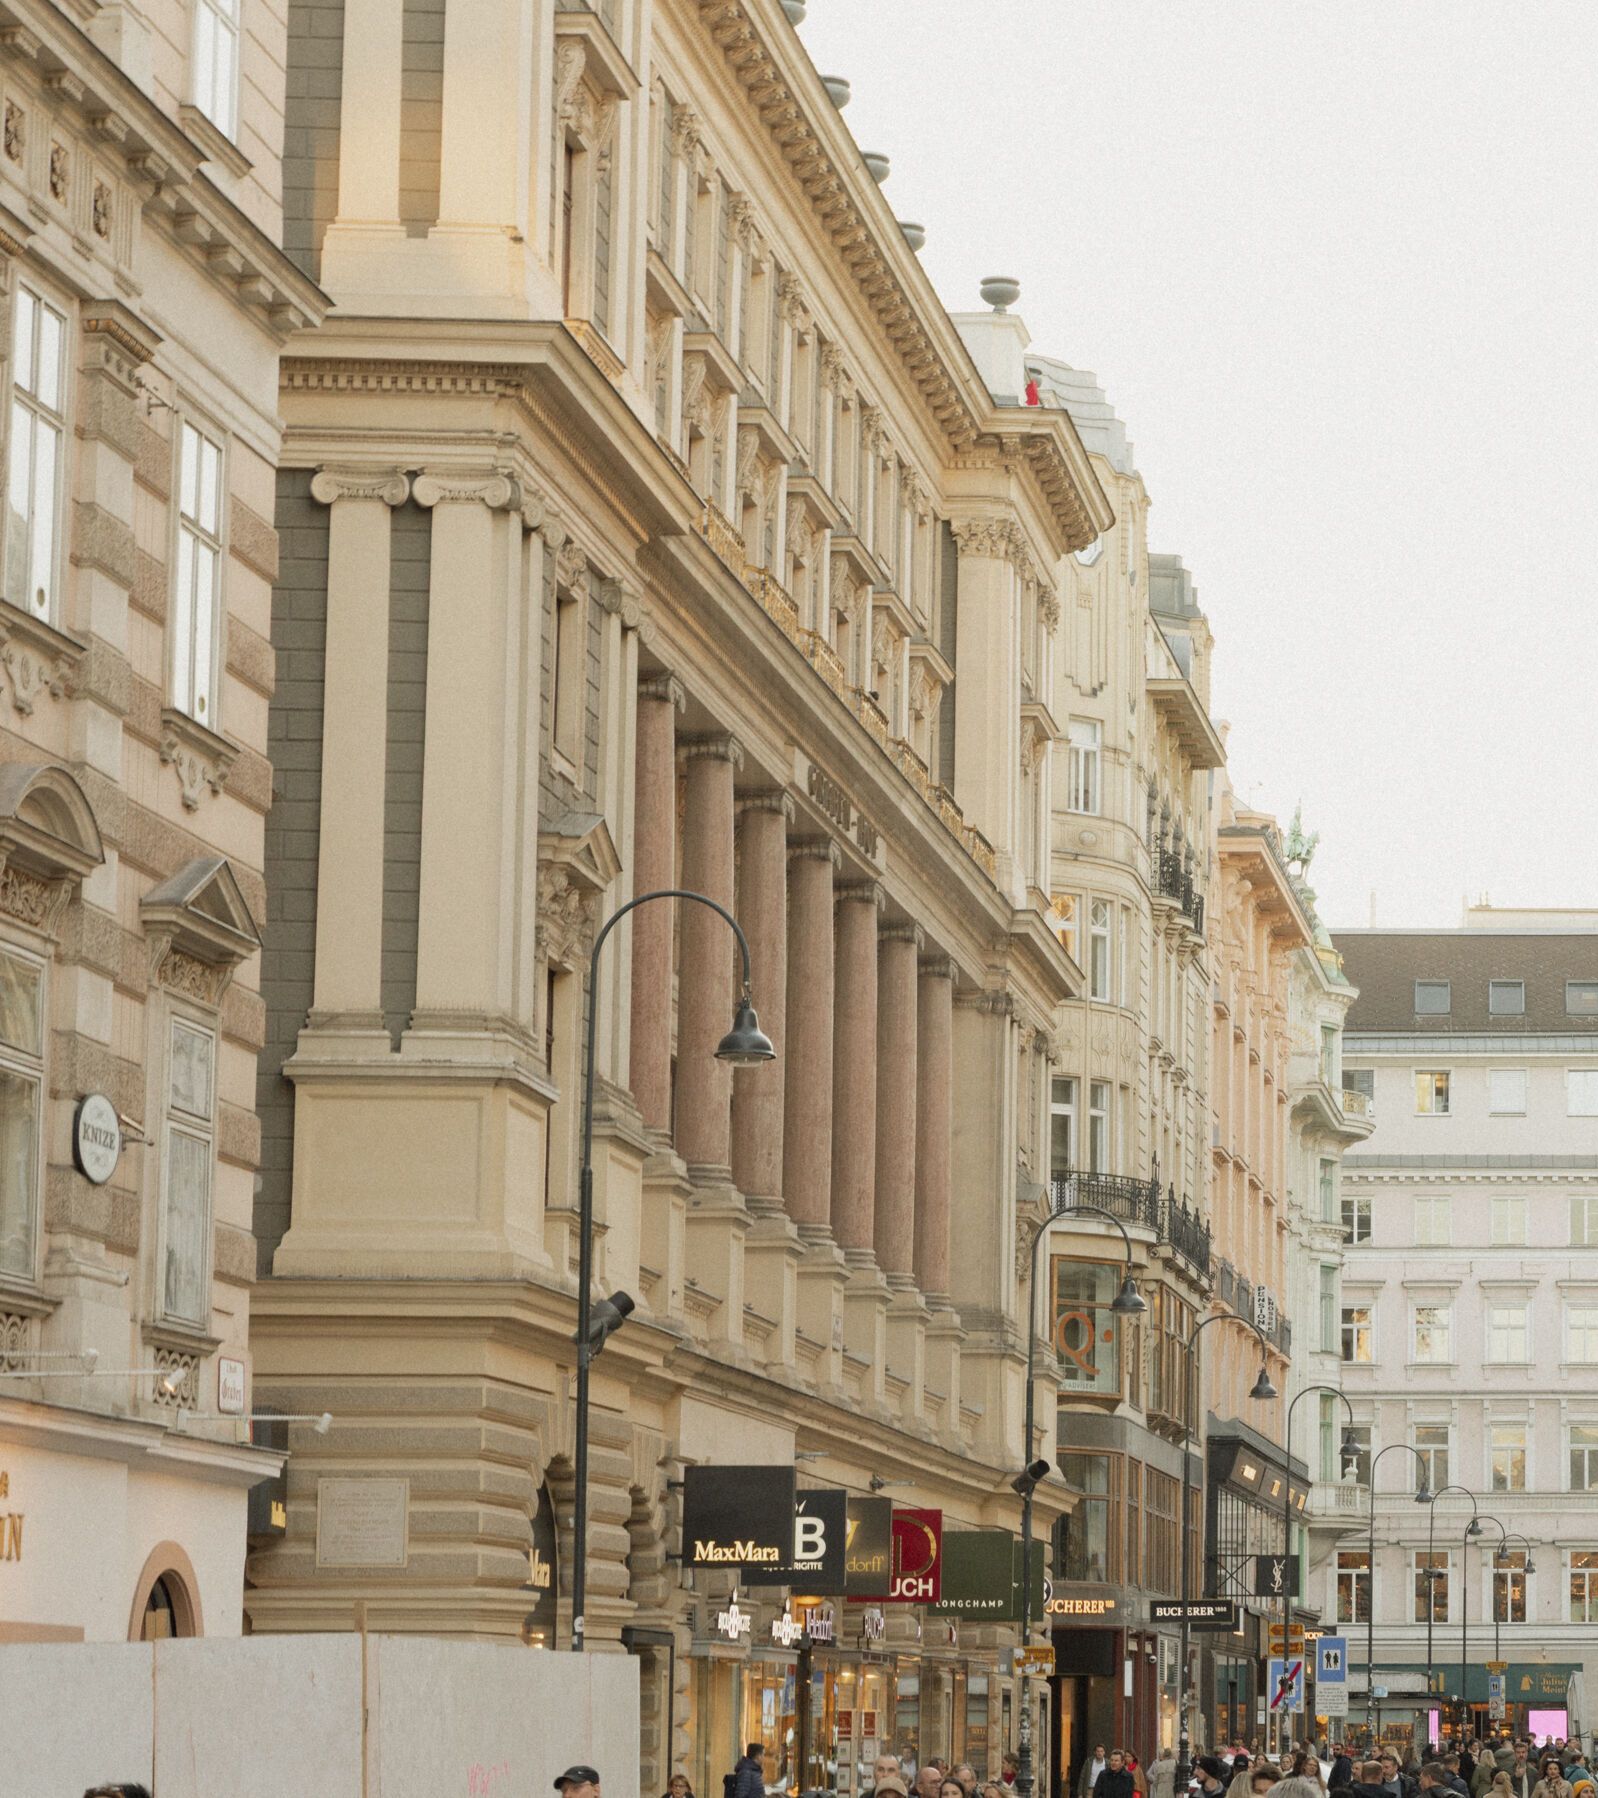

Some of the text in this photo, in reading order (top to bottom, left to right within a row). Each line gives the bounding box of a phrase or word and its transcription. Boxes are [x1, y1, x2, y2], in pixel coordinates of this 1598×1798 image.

[83, 1122, 116, 1151] KNIZE
[1257, 1285, 1266, 1326] PENSION
[694, 1540, 780, 1562] MaxMara
[790, 1561, 823, 1571] RIGITTE
[846, 1555, 885, 1573] dorff
[891, 1577, 934, 1597] UCH
[936, 1600, 1004, 1608] LONGCHAMP
[1046, 1600, 1105, 1614] UCHERER
